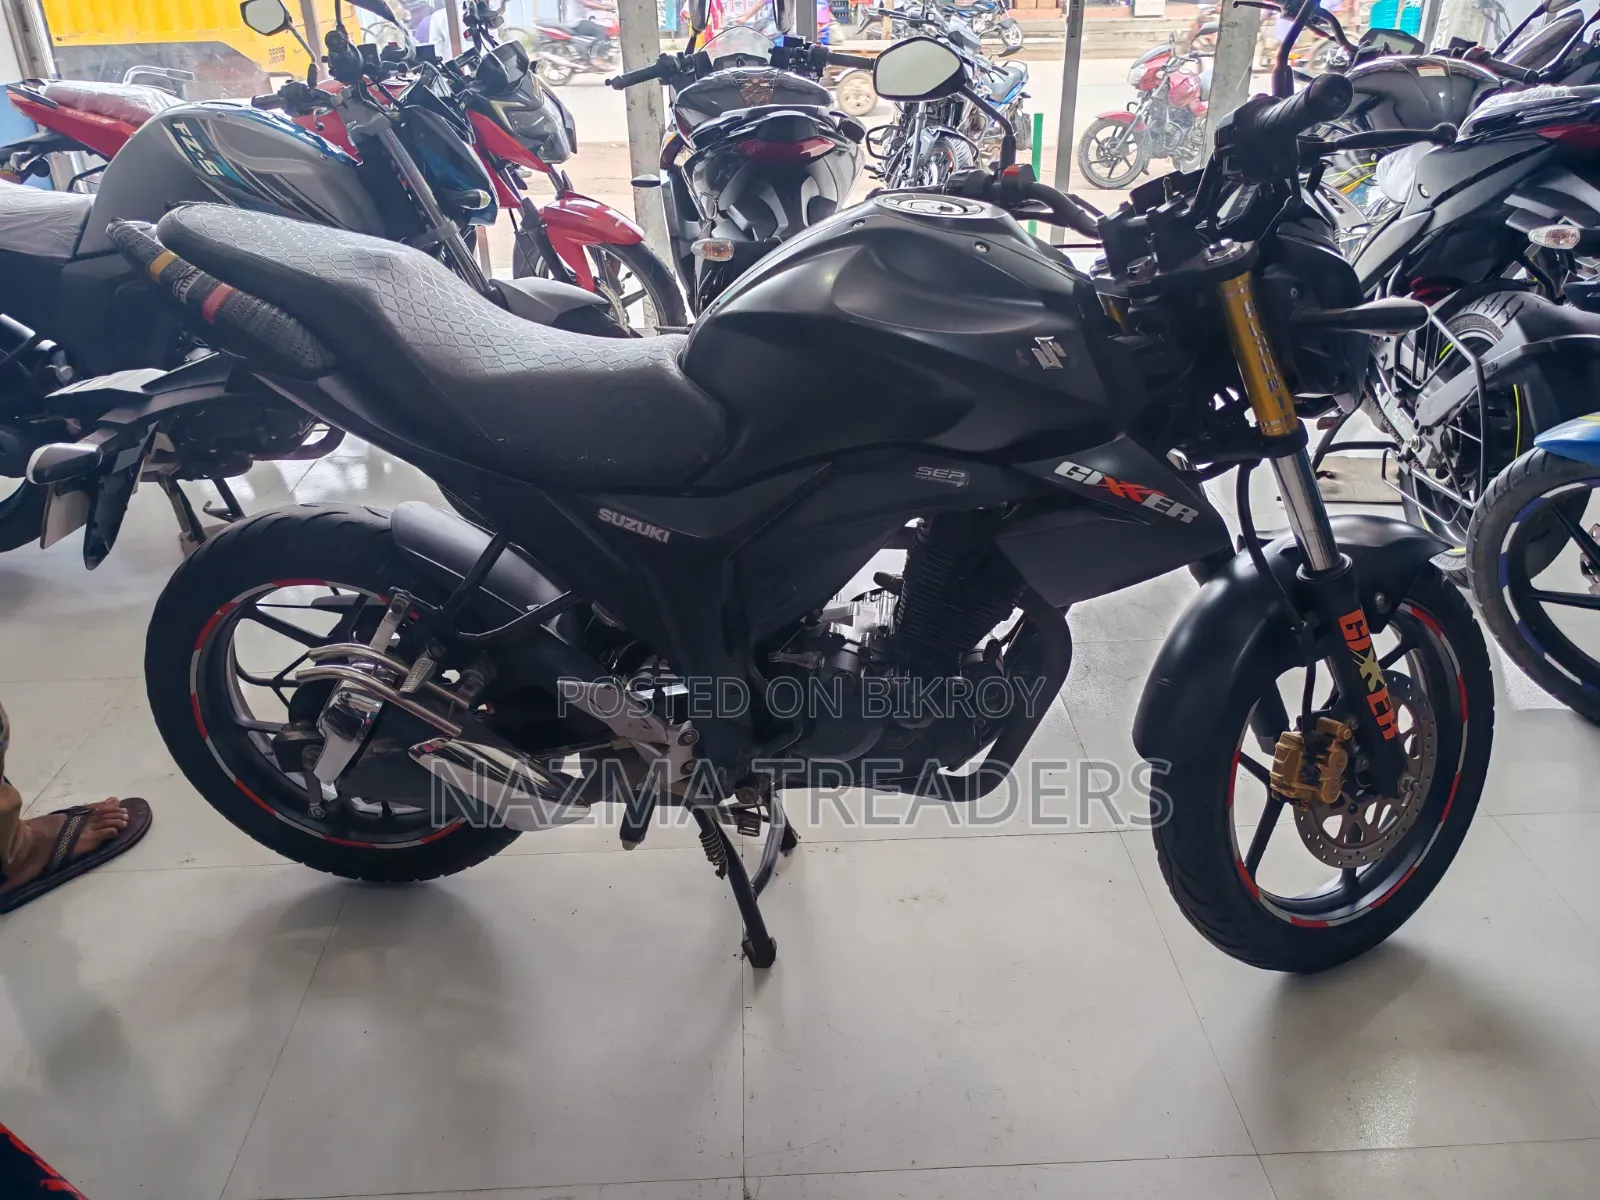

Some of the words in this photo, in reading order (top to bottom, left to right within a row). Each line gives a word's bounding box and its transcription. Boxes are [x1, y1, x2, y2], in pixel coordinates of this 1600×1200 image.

[915, 466, 966, 479] SEP
[1054, 460, 1199, 524] GIXXER
[598, 508, 671, 543] SUZUKI
